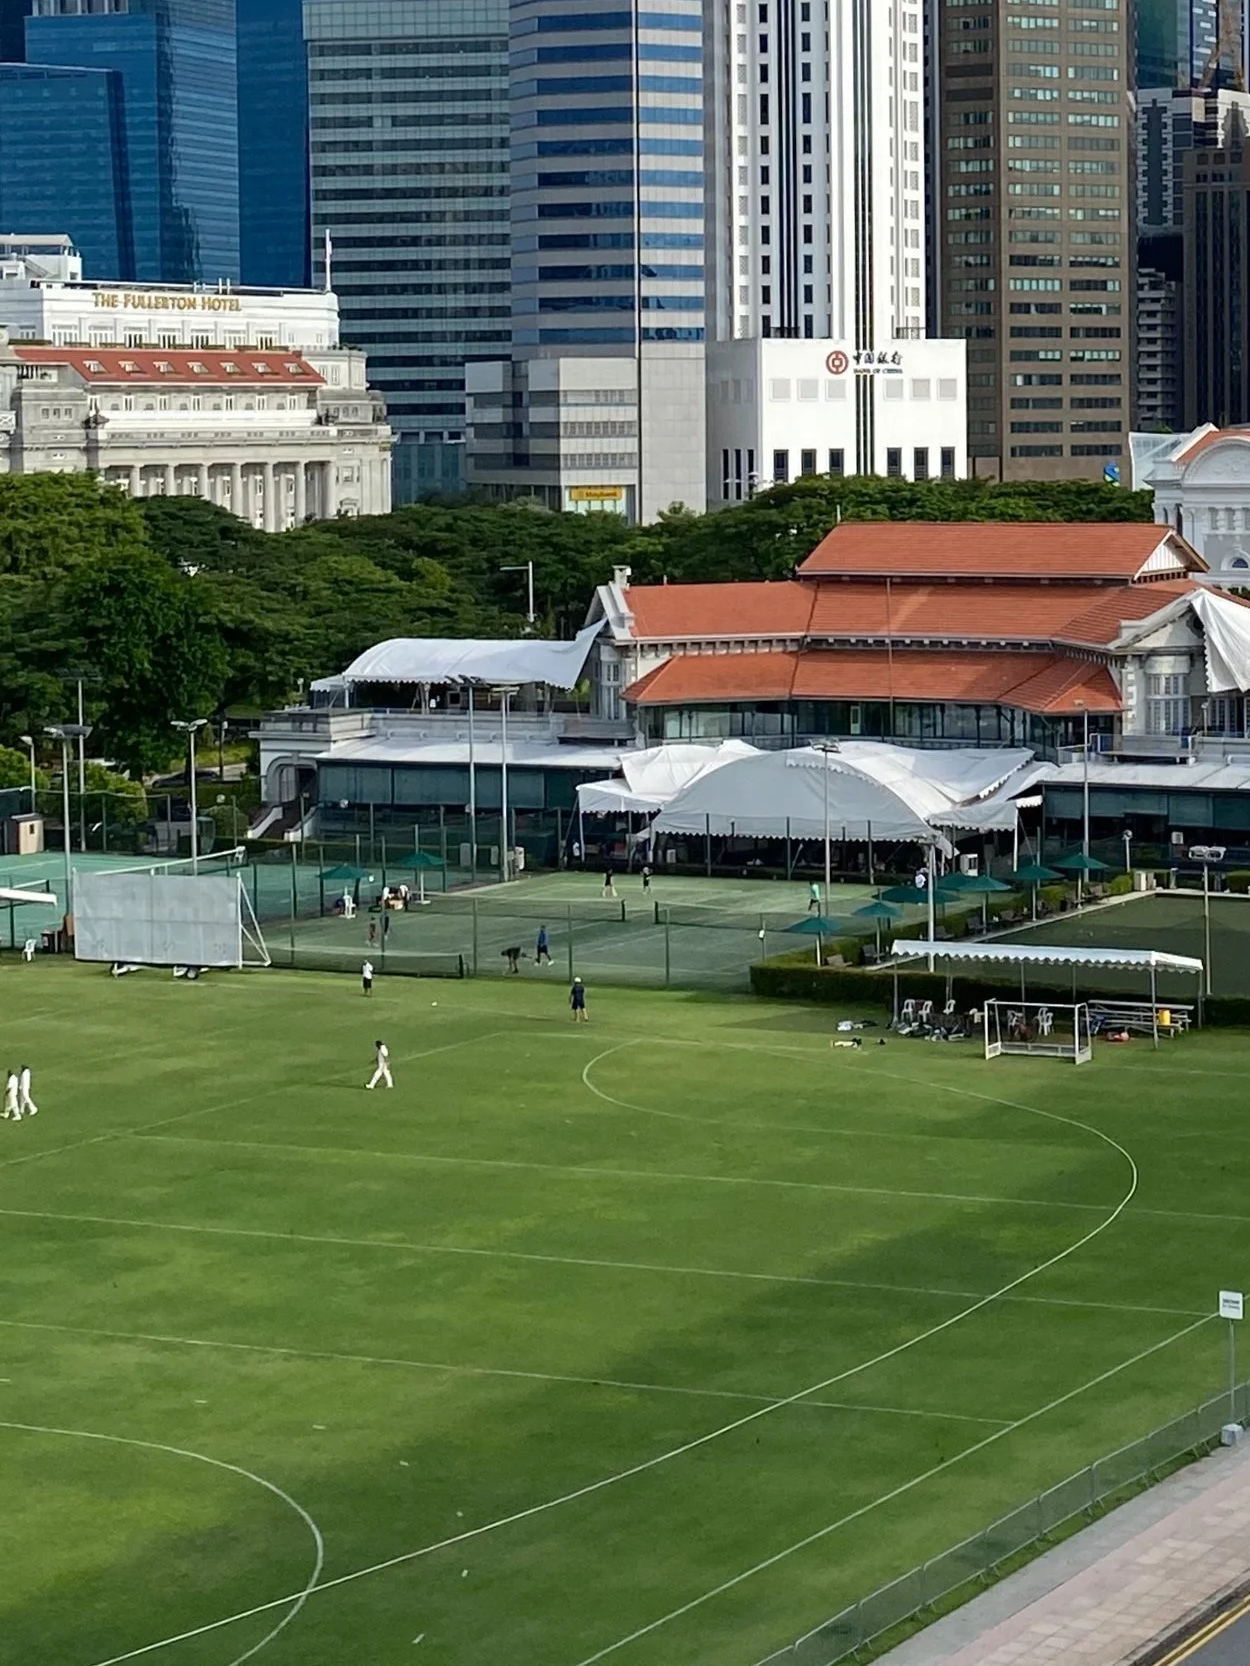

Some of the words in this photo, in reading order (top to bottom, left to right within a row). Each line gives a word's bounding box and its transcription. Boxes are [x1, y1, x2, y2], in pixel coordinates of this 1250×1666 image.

[92, 293, 119, 308] THE
[123, 294, 197, 310] FULLERTON
[201, 296, 242, 312] HOTEL
